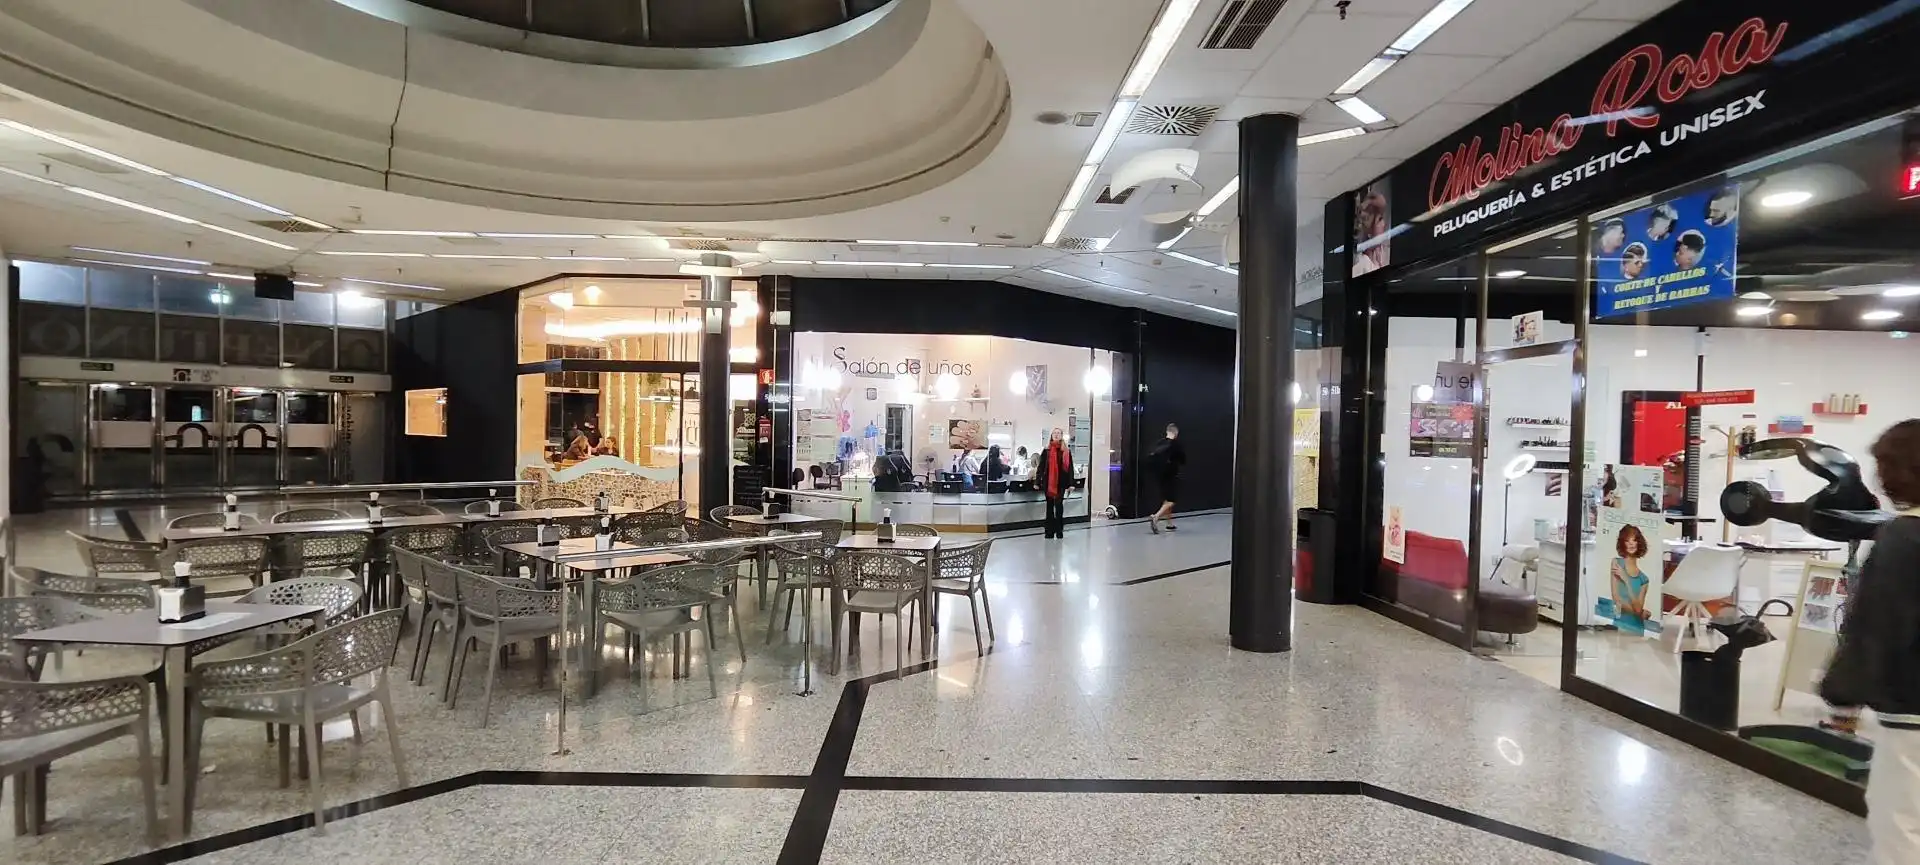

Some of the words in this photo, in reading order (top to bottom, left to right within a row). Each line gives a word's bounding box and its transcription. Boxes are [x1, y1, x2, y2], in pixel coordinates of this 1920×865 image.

[1429, 113, 1584, 213] Molina
[1589, 17, 1788, 137] Rosa
[1433, 187, 1527, 238] PELUQUERÍA
[1531, 182, 1546, 199] &
[1551, 141, 1652, 194] ESTÉTICA
[1660, 89, 1767, 148] UNISEX
[1614, 280, 1643, 293] CORTE
[1644, 277, 1657, 288] DE
[1658, 267, 1707, 285] CABELLOS
[1655, 285, 1662, 294] Y
[1614, 294, 1654, 310] RETOQUE
[1655, 292, 1668, 303] DE
[1669, 285, 1711, 300] BARBAS
[830, 346, 890, 375] Salón
[896, 358, 921, 375] de
[928, 359, 972, 377] uñas
